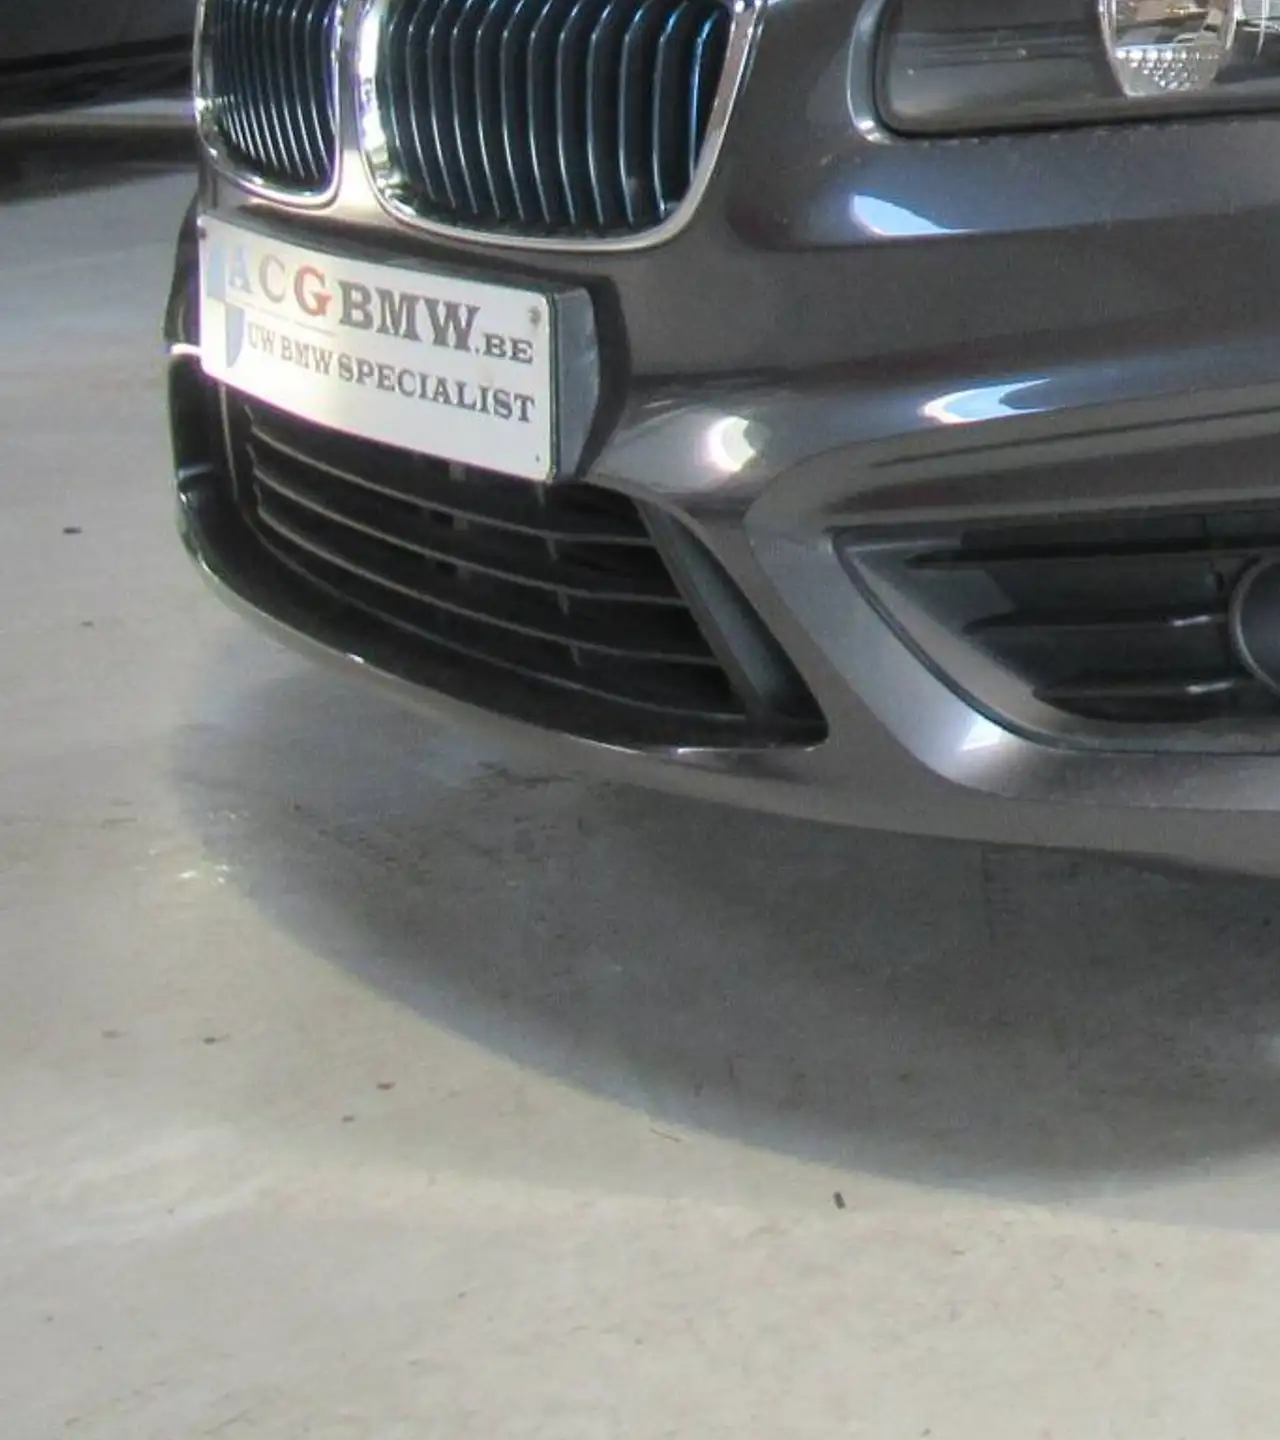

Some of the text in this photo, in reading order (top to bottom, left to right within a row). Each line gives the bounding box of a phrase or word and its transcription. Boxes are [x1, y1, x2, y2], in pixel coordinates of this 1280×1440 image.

[247, 322, 536, 423] UW BMW SPECIALIST
